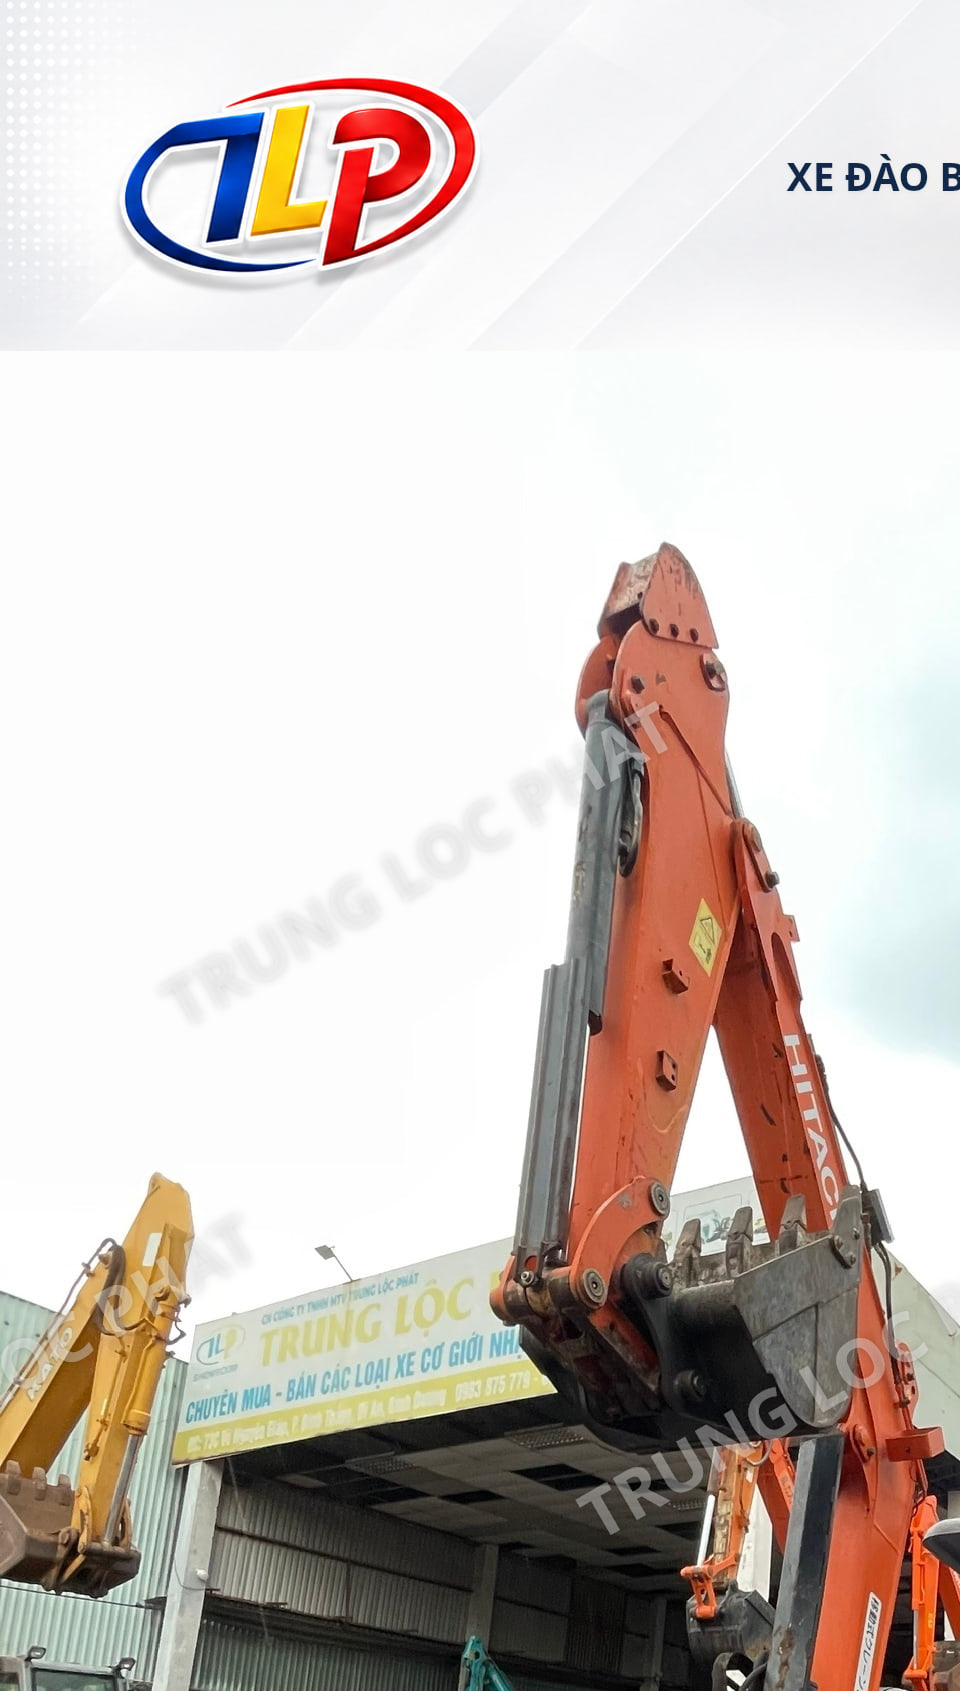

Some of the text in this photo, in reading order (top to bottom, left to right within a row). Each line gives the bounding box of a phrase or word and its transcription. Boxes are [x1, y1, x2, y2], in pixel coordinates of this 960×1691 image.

[261, 1302, 381, 1368] TRUNG
[395, 1275, 474, 1338] LỘC
[186, 1388, 238, 1424] CHUYÊN
[241, 1384, 271, 1412] MUA
[285, 1371, 316, 1402] BÁN
[320, 1364, 351, 1395] CÁC
[354, 1356, 391, 1389] LOẠI
[394, 1351, 417, 1380] XE
[420, 1341, 445, 1374] CƠ
[448, 1331, 484, 1368] GIỚI
